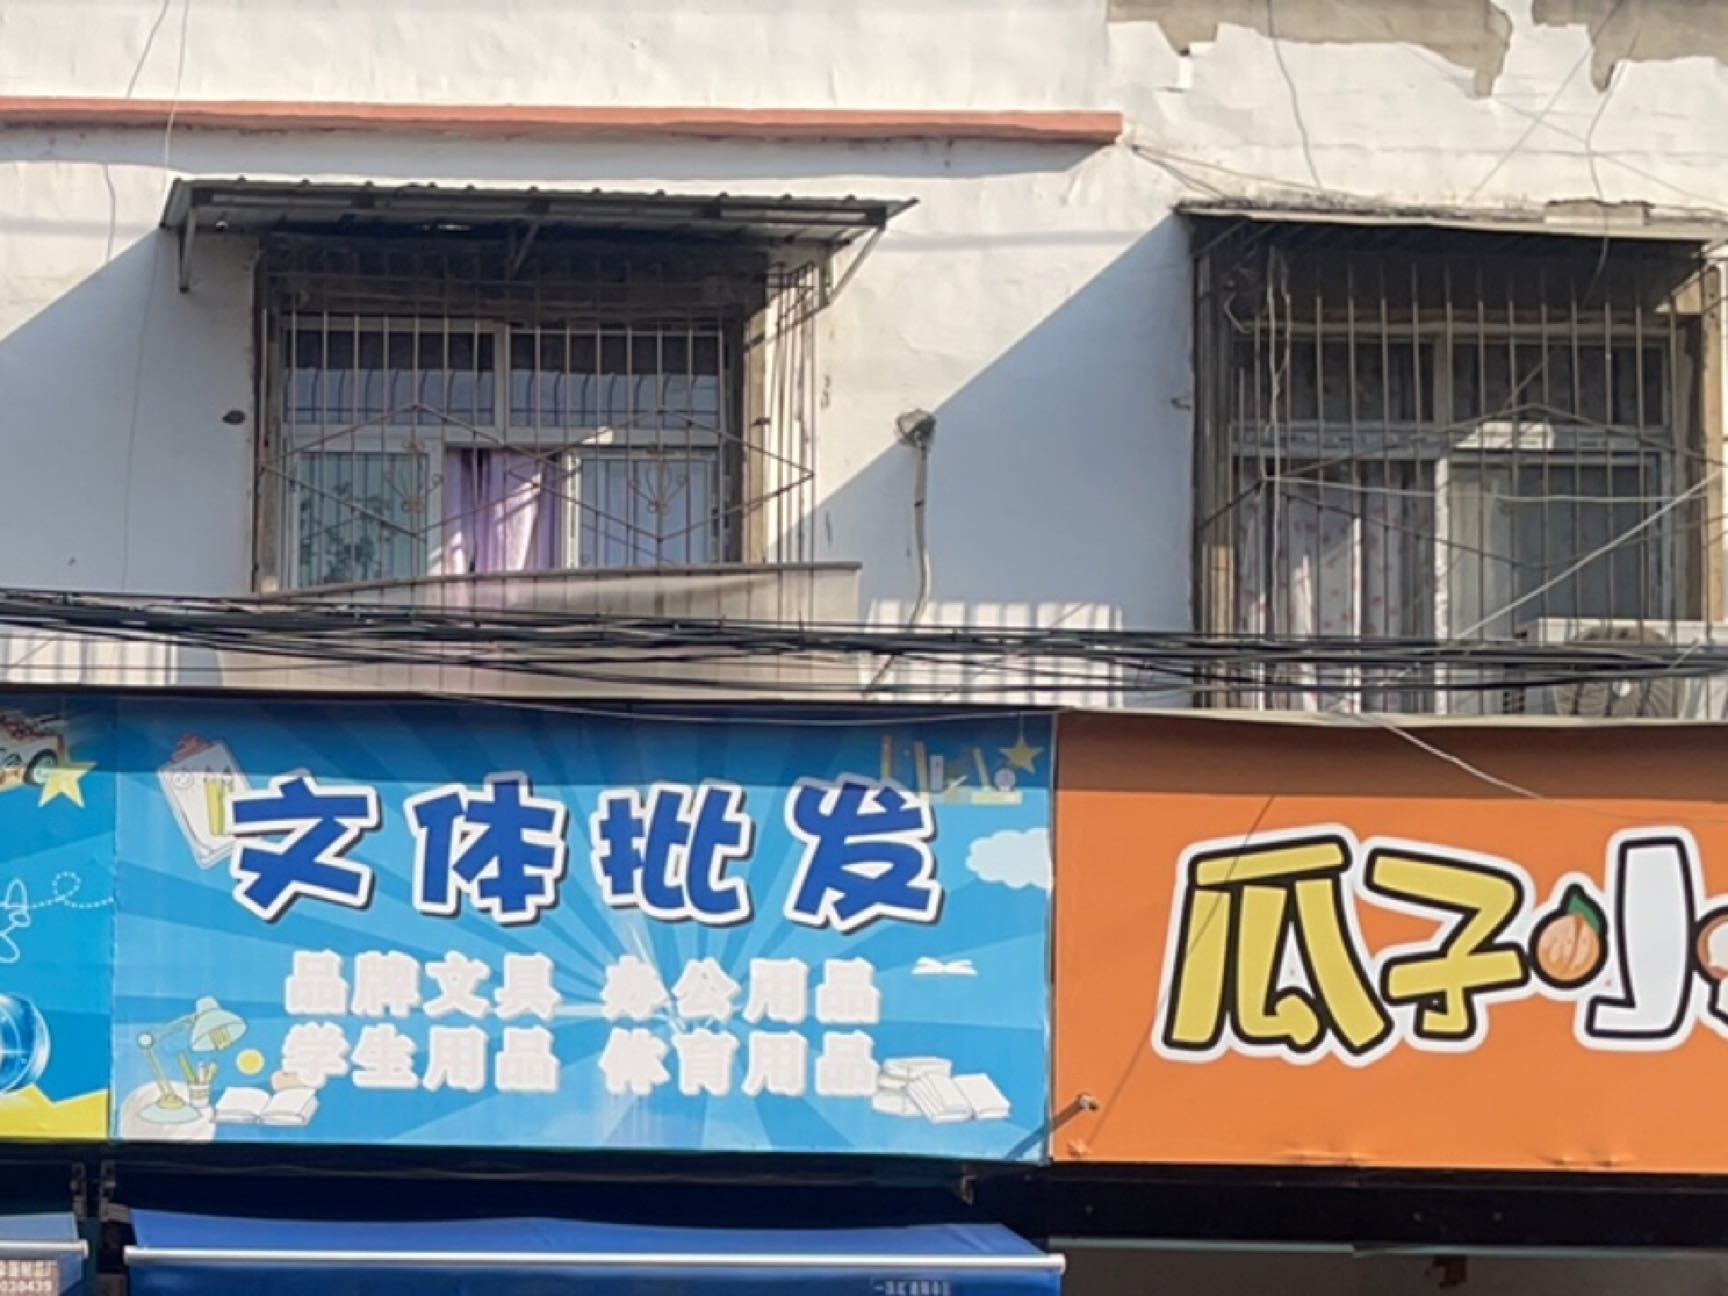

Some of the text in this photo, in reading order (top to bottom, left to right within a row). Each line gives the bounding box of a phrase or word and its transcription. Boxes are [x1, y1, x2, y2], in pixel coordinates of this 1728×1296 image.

[229, 770, 943, 933] 文体批发
[284, 949, 879, 1023] 品牌文具 办公用品
[1155, 826, 1728, 1062] 瓜子小
[282, 1022, 879, 1095] 学生用品 体育用品
